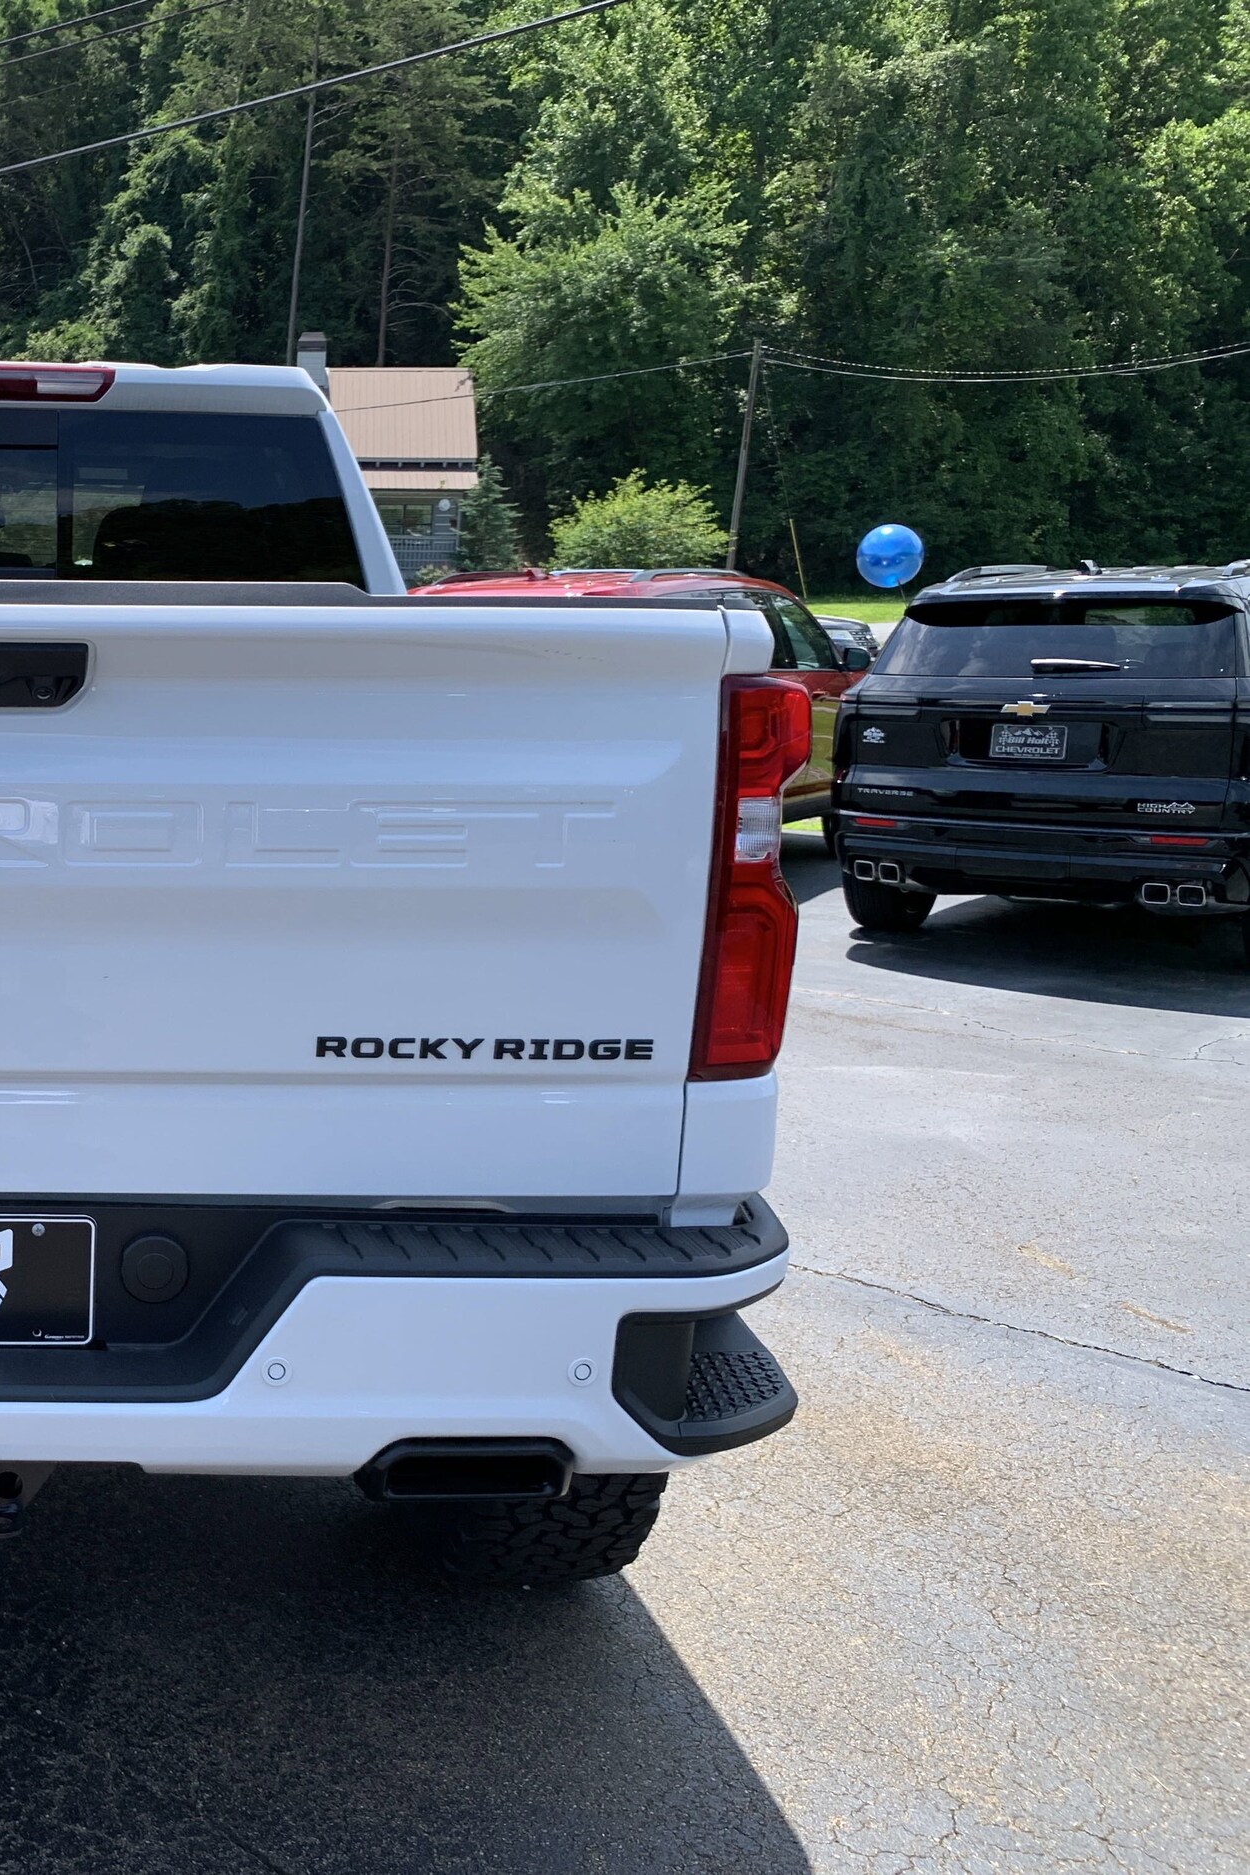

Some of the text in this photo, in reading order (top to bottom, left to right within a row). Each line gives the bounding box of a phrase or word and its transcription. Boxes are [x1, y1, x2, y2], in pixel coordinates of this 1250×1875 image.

[995, 745, 1061, 755] CHEVROLET
[857, 787, 914, 797] TRAVERSE
[1137, 807, 1195, 815] COUNTRY
[314, 1035, 655, 1061] ROCKY RIDGE
